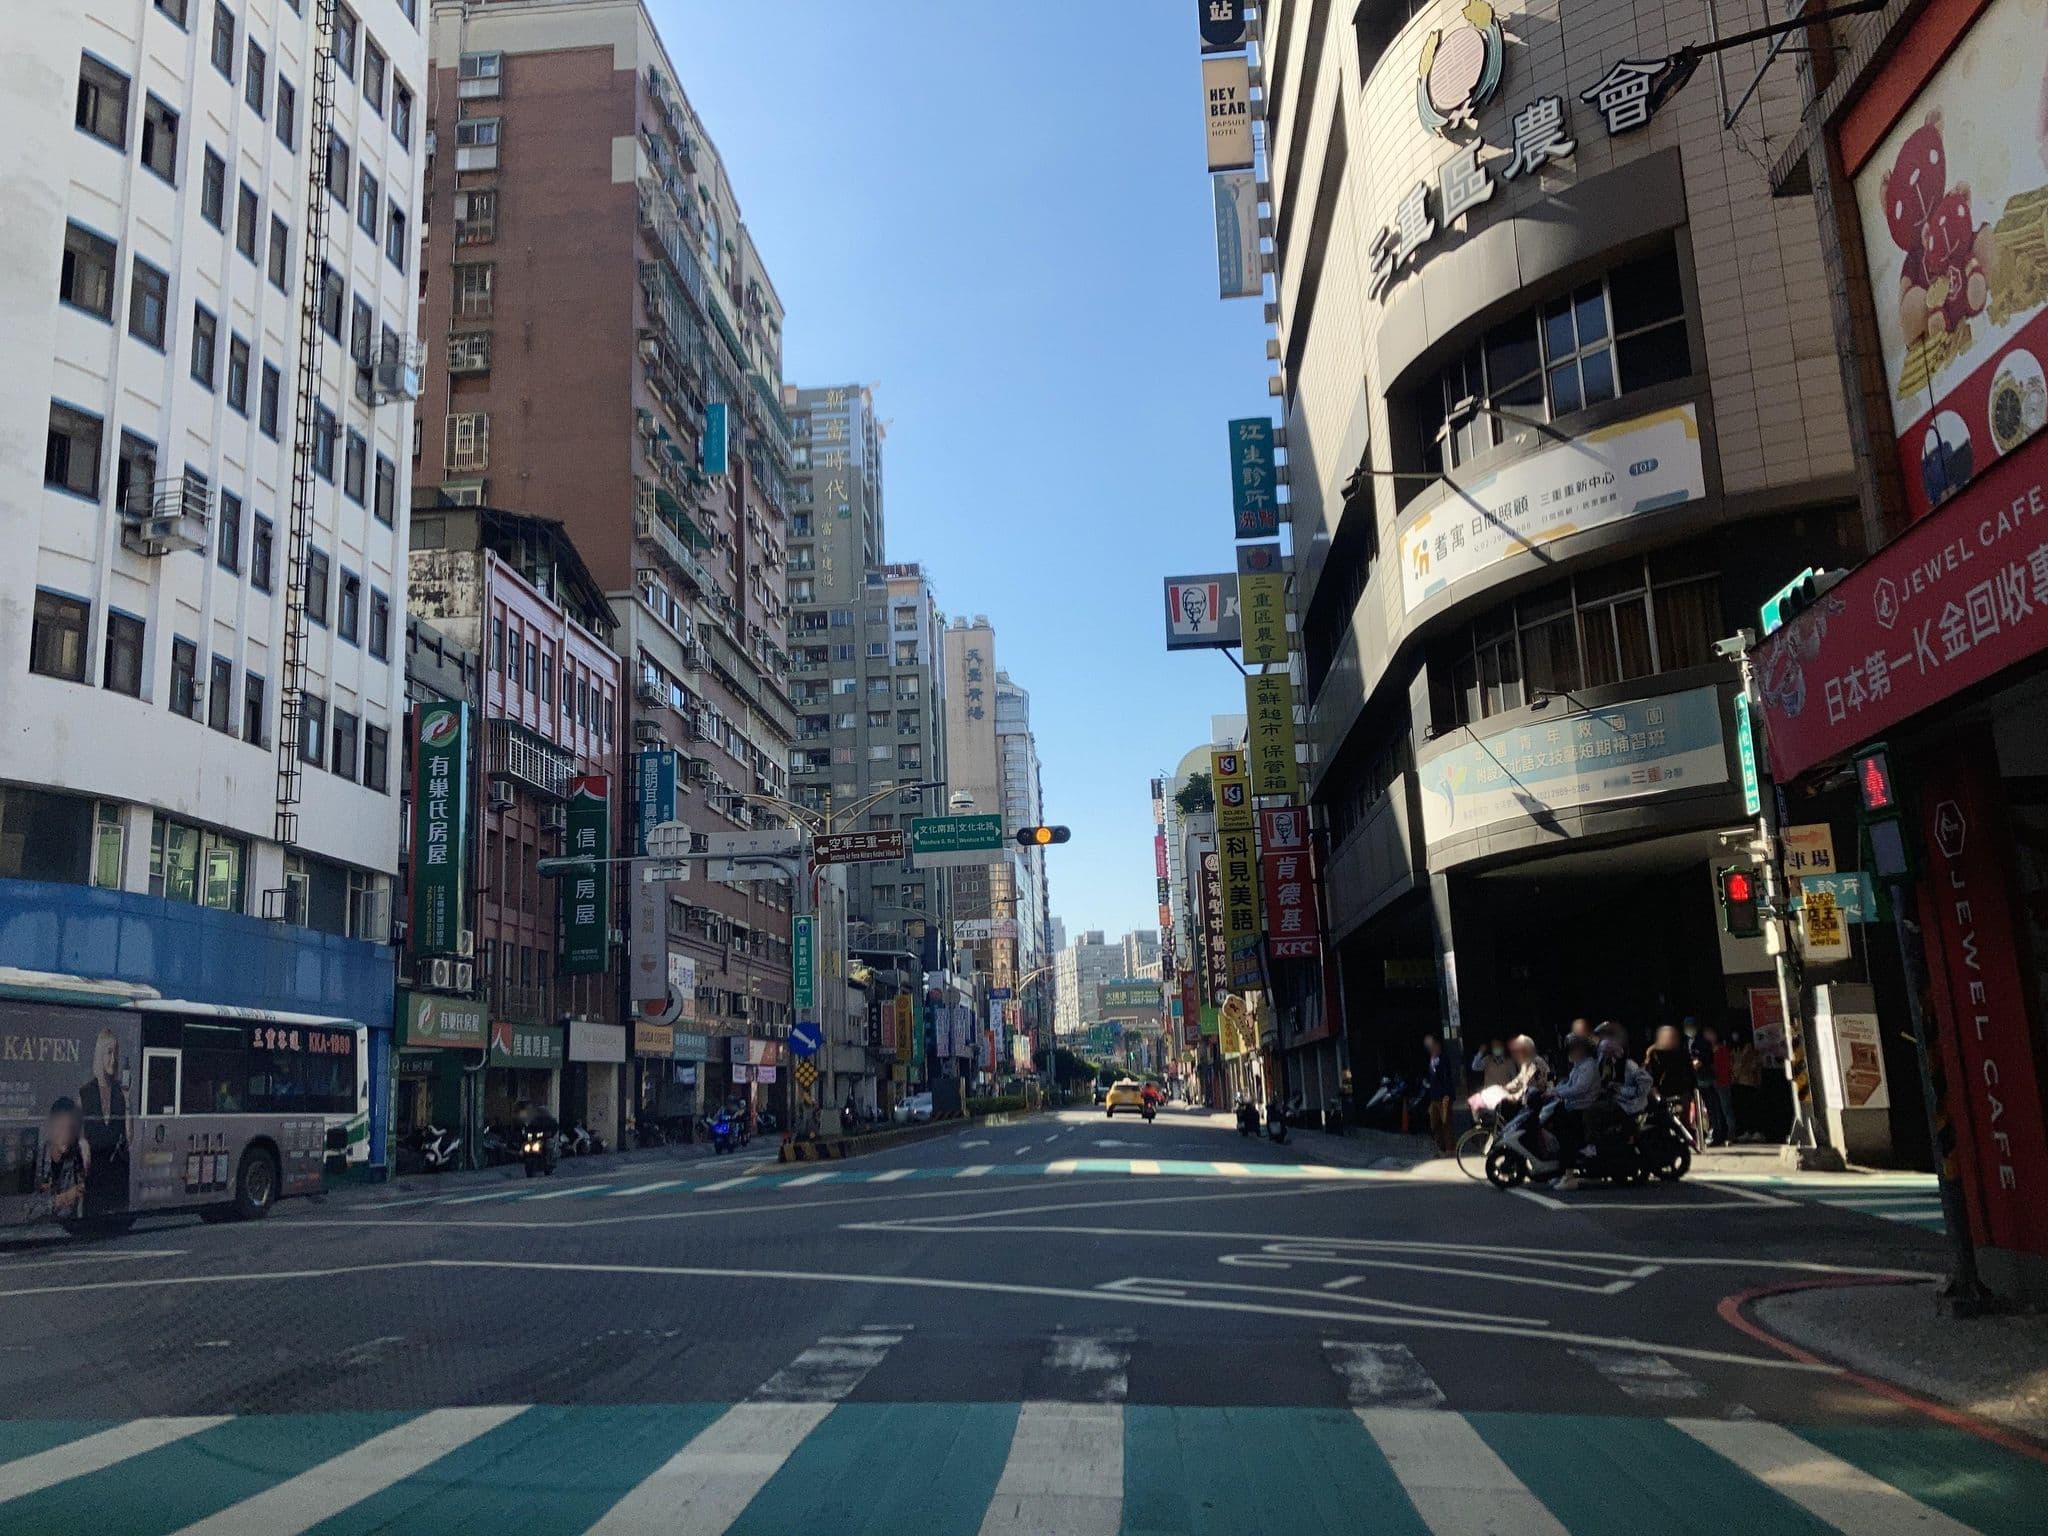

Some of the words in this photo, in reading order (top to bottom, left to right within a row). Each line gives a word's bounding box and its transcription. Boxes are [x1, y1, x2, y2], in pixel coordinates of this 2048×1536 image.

[1209, 86, 1236, 101] HEY
[1210, 102, 1247, 117] BEAR
[1211, 118, 1246, 128] CAPSULE
[1211, 128, 1238, 137] HOTEL
[1366, 58, 1672, 302] 三重區農會
[1239, 423, 1270, 508] 江生診所
[1901, 536, 1974, 602] JEWEL
[1977, 484, 2046, 547] CAFE
[1250, 576, 1276, 660] 三重區農會
[426, 755, 450, 865] 有巢氏房屋
[919, 826, 955, 835] 文化南路
[958, 822, 995, 832] 文化北路
[828, 833, 901, 851] 空軍三重一村
[1226, 836, 1254, 931] 科見美語
[1276, 856, 1303, 933] 肯德基
[1274, 939, 1314, 956] KFC
[440, 1011, 480, 1032] 有巢氏房屋
[1950, 870, 1991, 1041] JEWEL
[1982, 1058, 2016, 1190] CAFE
[513, 1033, 551, 1057] 信義房屋
